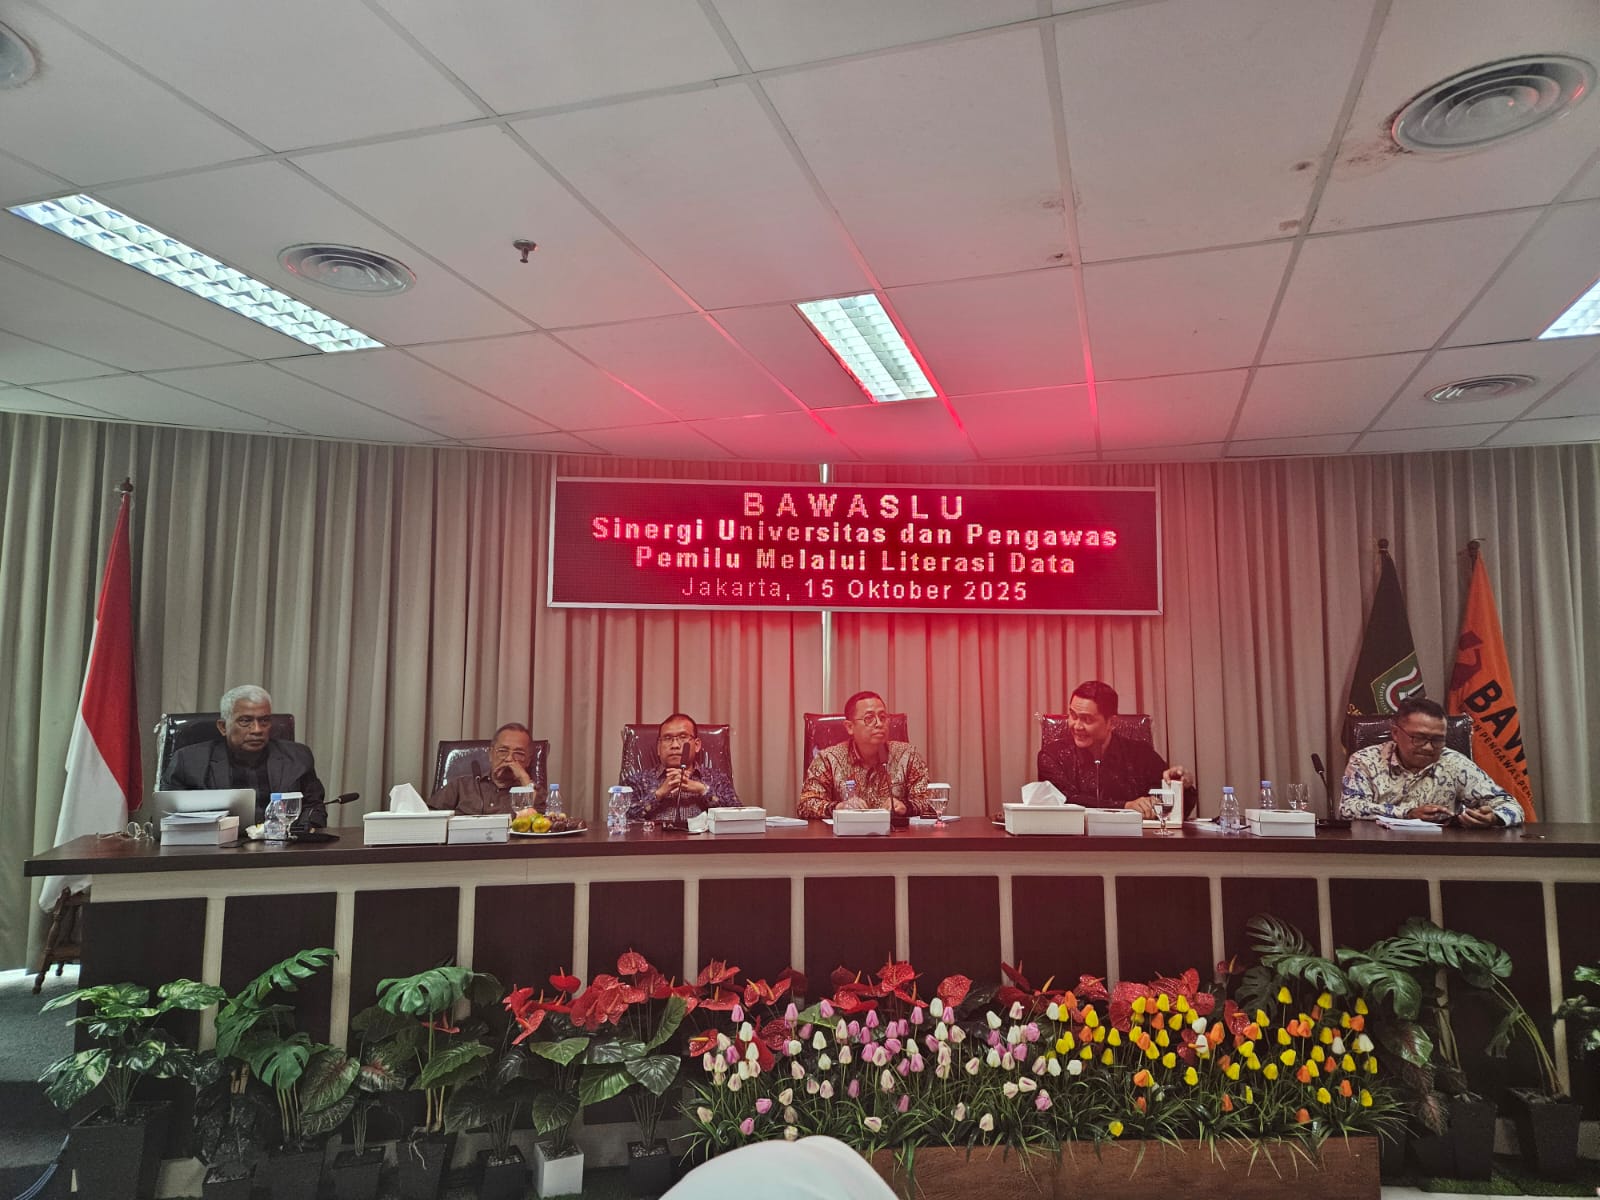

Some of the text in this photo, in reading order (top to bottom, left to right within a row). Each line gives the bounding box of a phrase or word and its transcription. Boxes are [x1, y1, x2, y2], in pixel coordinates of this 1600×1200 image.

[744, 492, 963, 520] BAWASLU
[592, 517, 1117, 550] Sinergi Universitas dan Pengawas
[636, 546, 1075, 574] Pemilu Melalui Literasi Data
[682, 577, 1027, 601] Jakarta, 15 Oktober 2025
[1464, 679, 1528, 777] BAW
